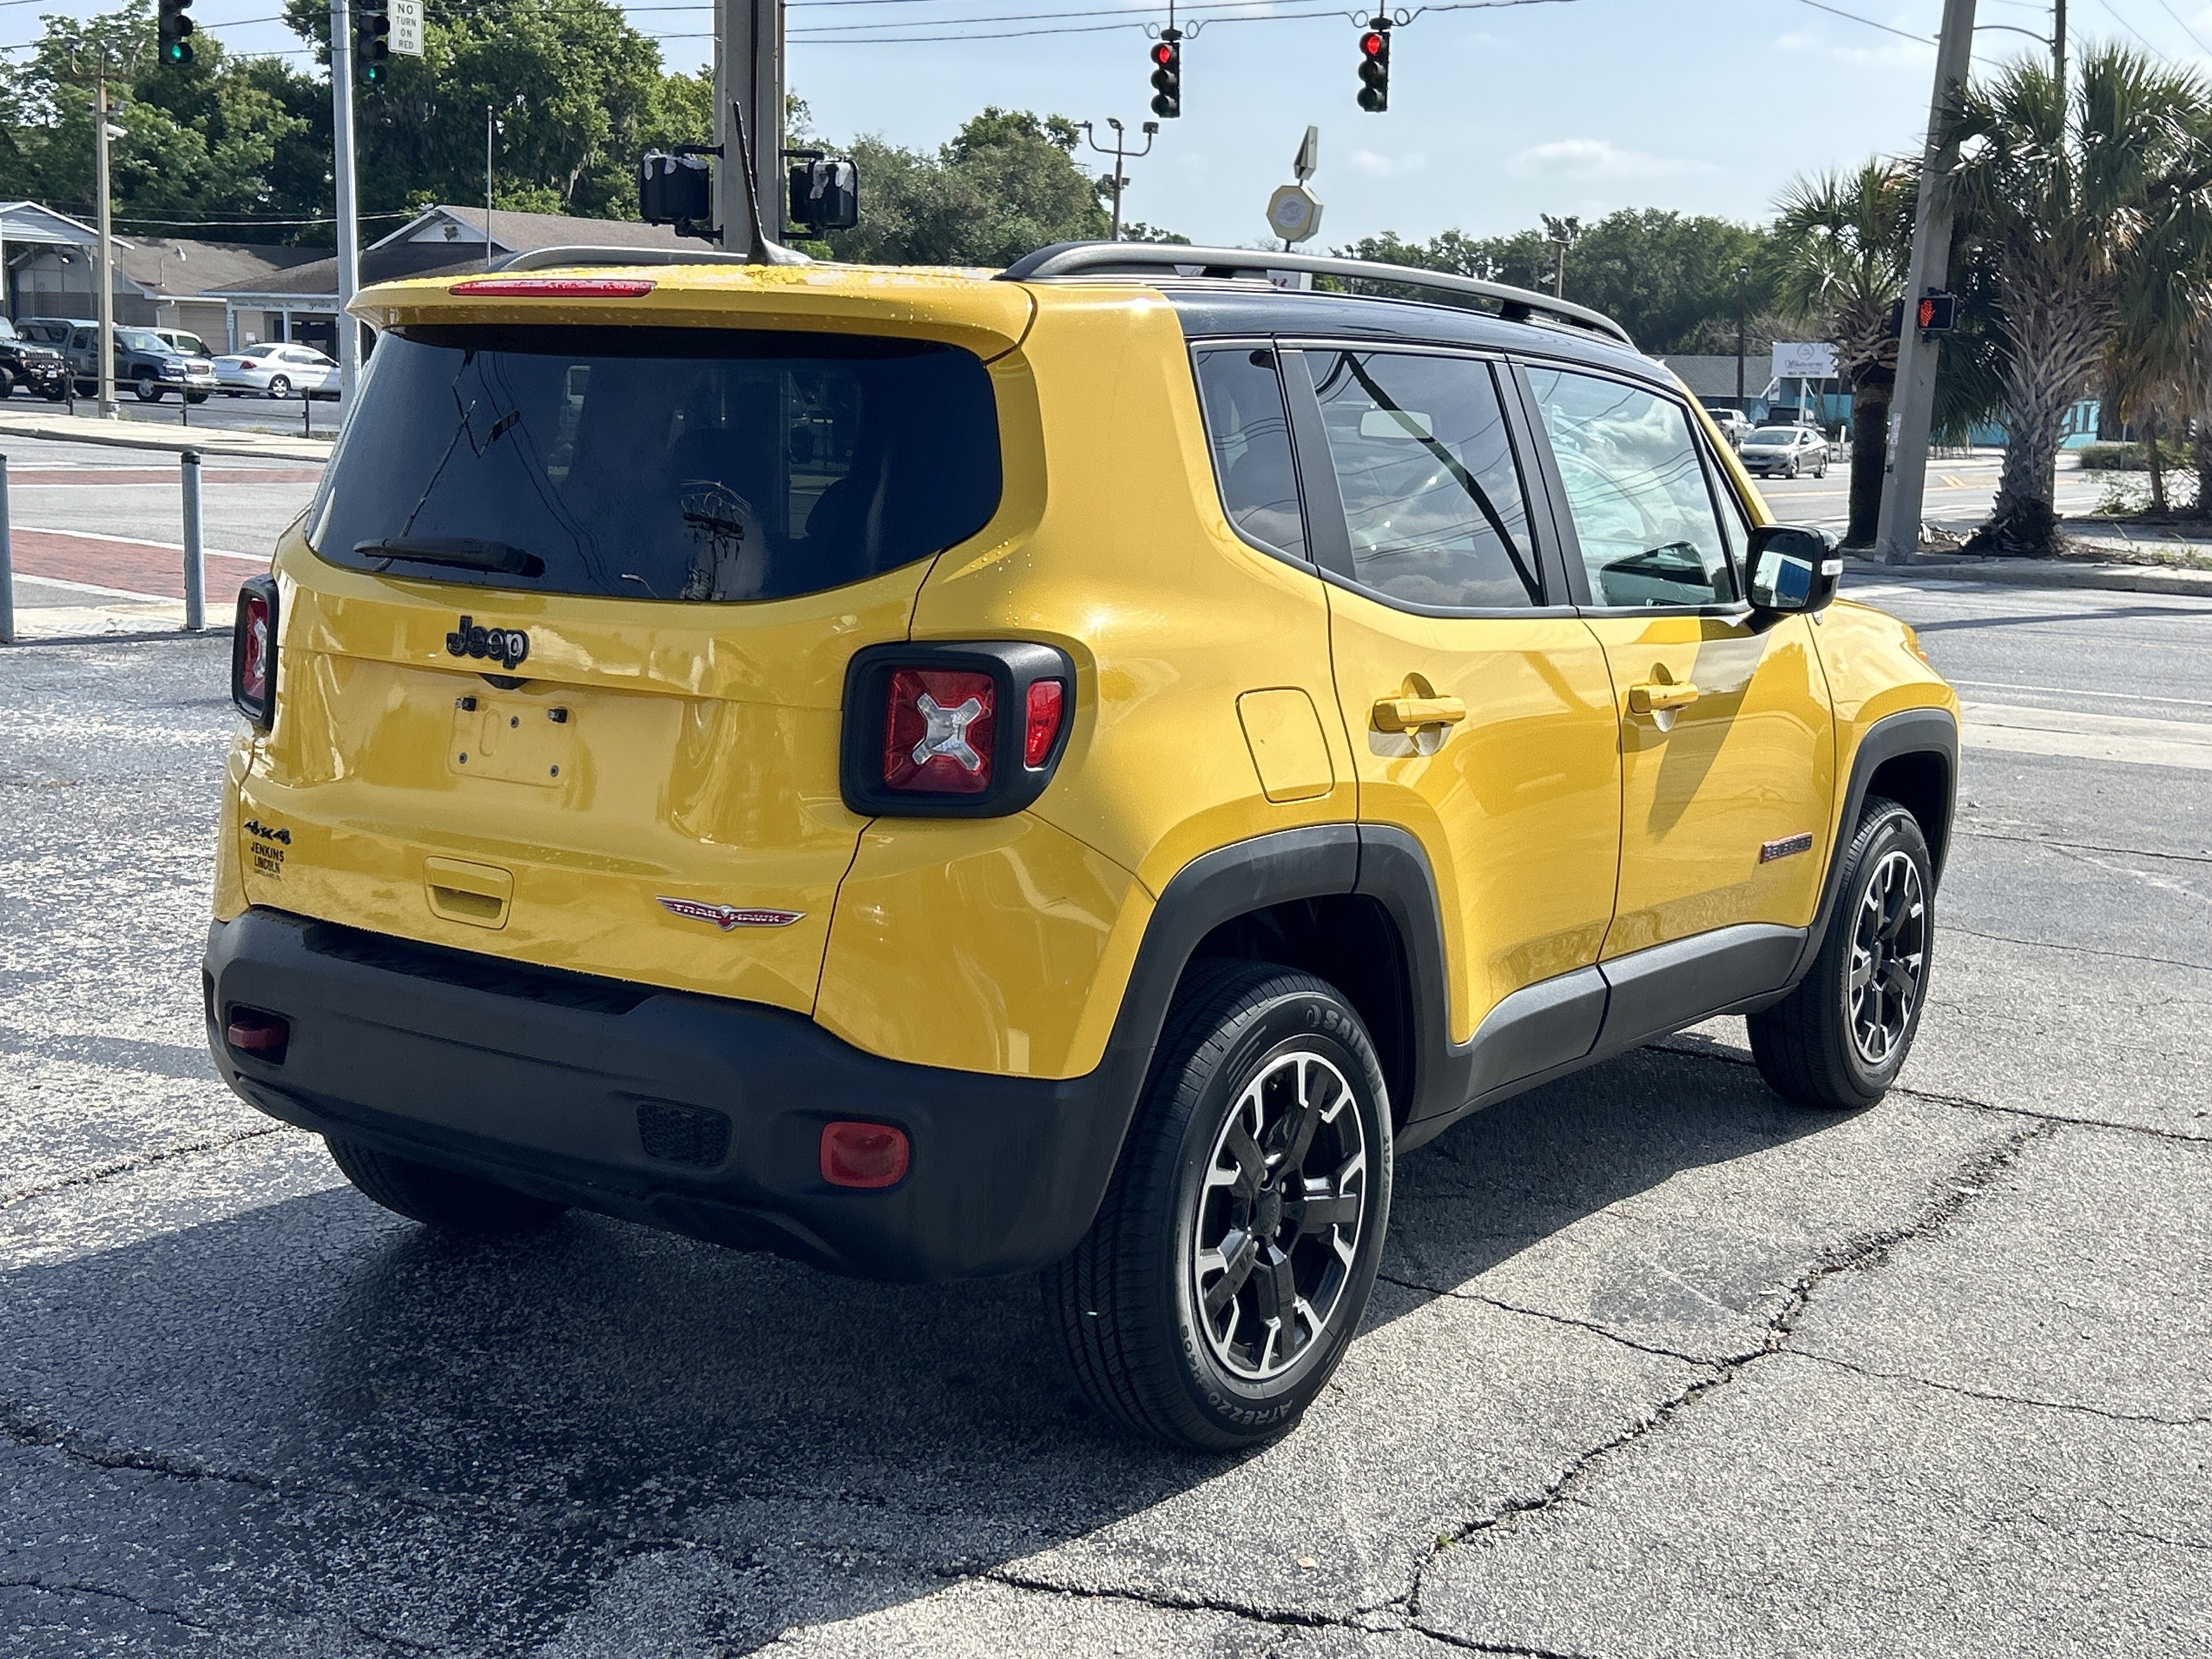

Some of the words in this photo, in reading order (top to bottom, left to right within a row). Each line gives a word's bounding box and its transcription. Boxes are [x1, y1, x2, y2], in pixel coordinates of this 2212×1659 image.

[398, 3, 414, 15] NO
[396, 16, 417, 27] TURN
[400, 28, 413, 38] ON
[398, 40, 415, 49] RED
[446, 615, 530, 670] Jeep
[251, 841, 285, 862] JENKINS
[254, 854, 281, 874] LINCOLN
[1207, 1391, 1294, 1425] ATREZZO
